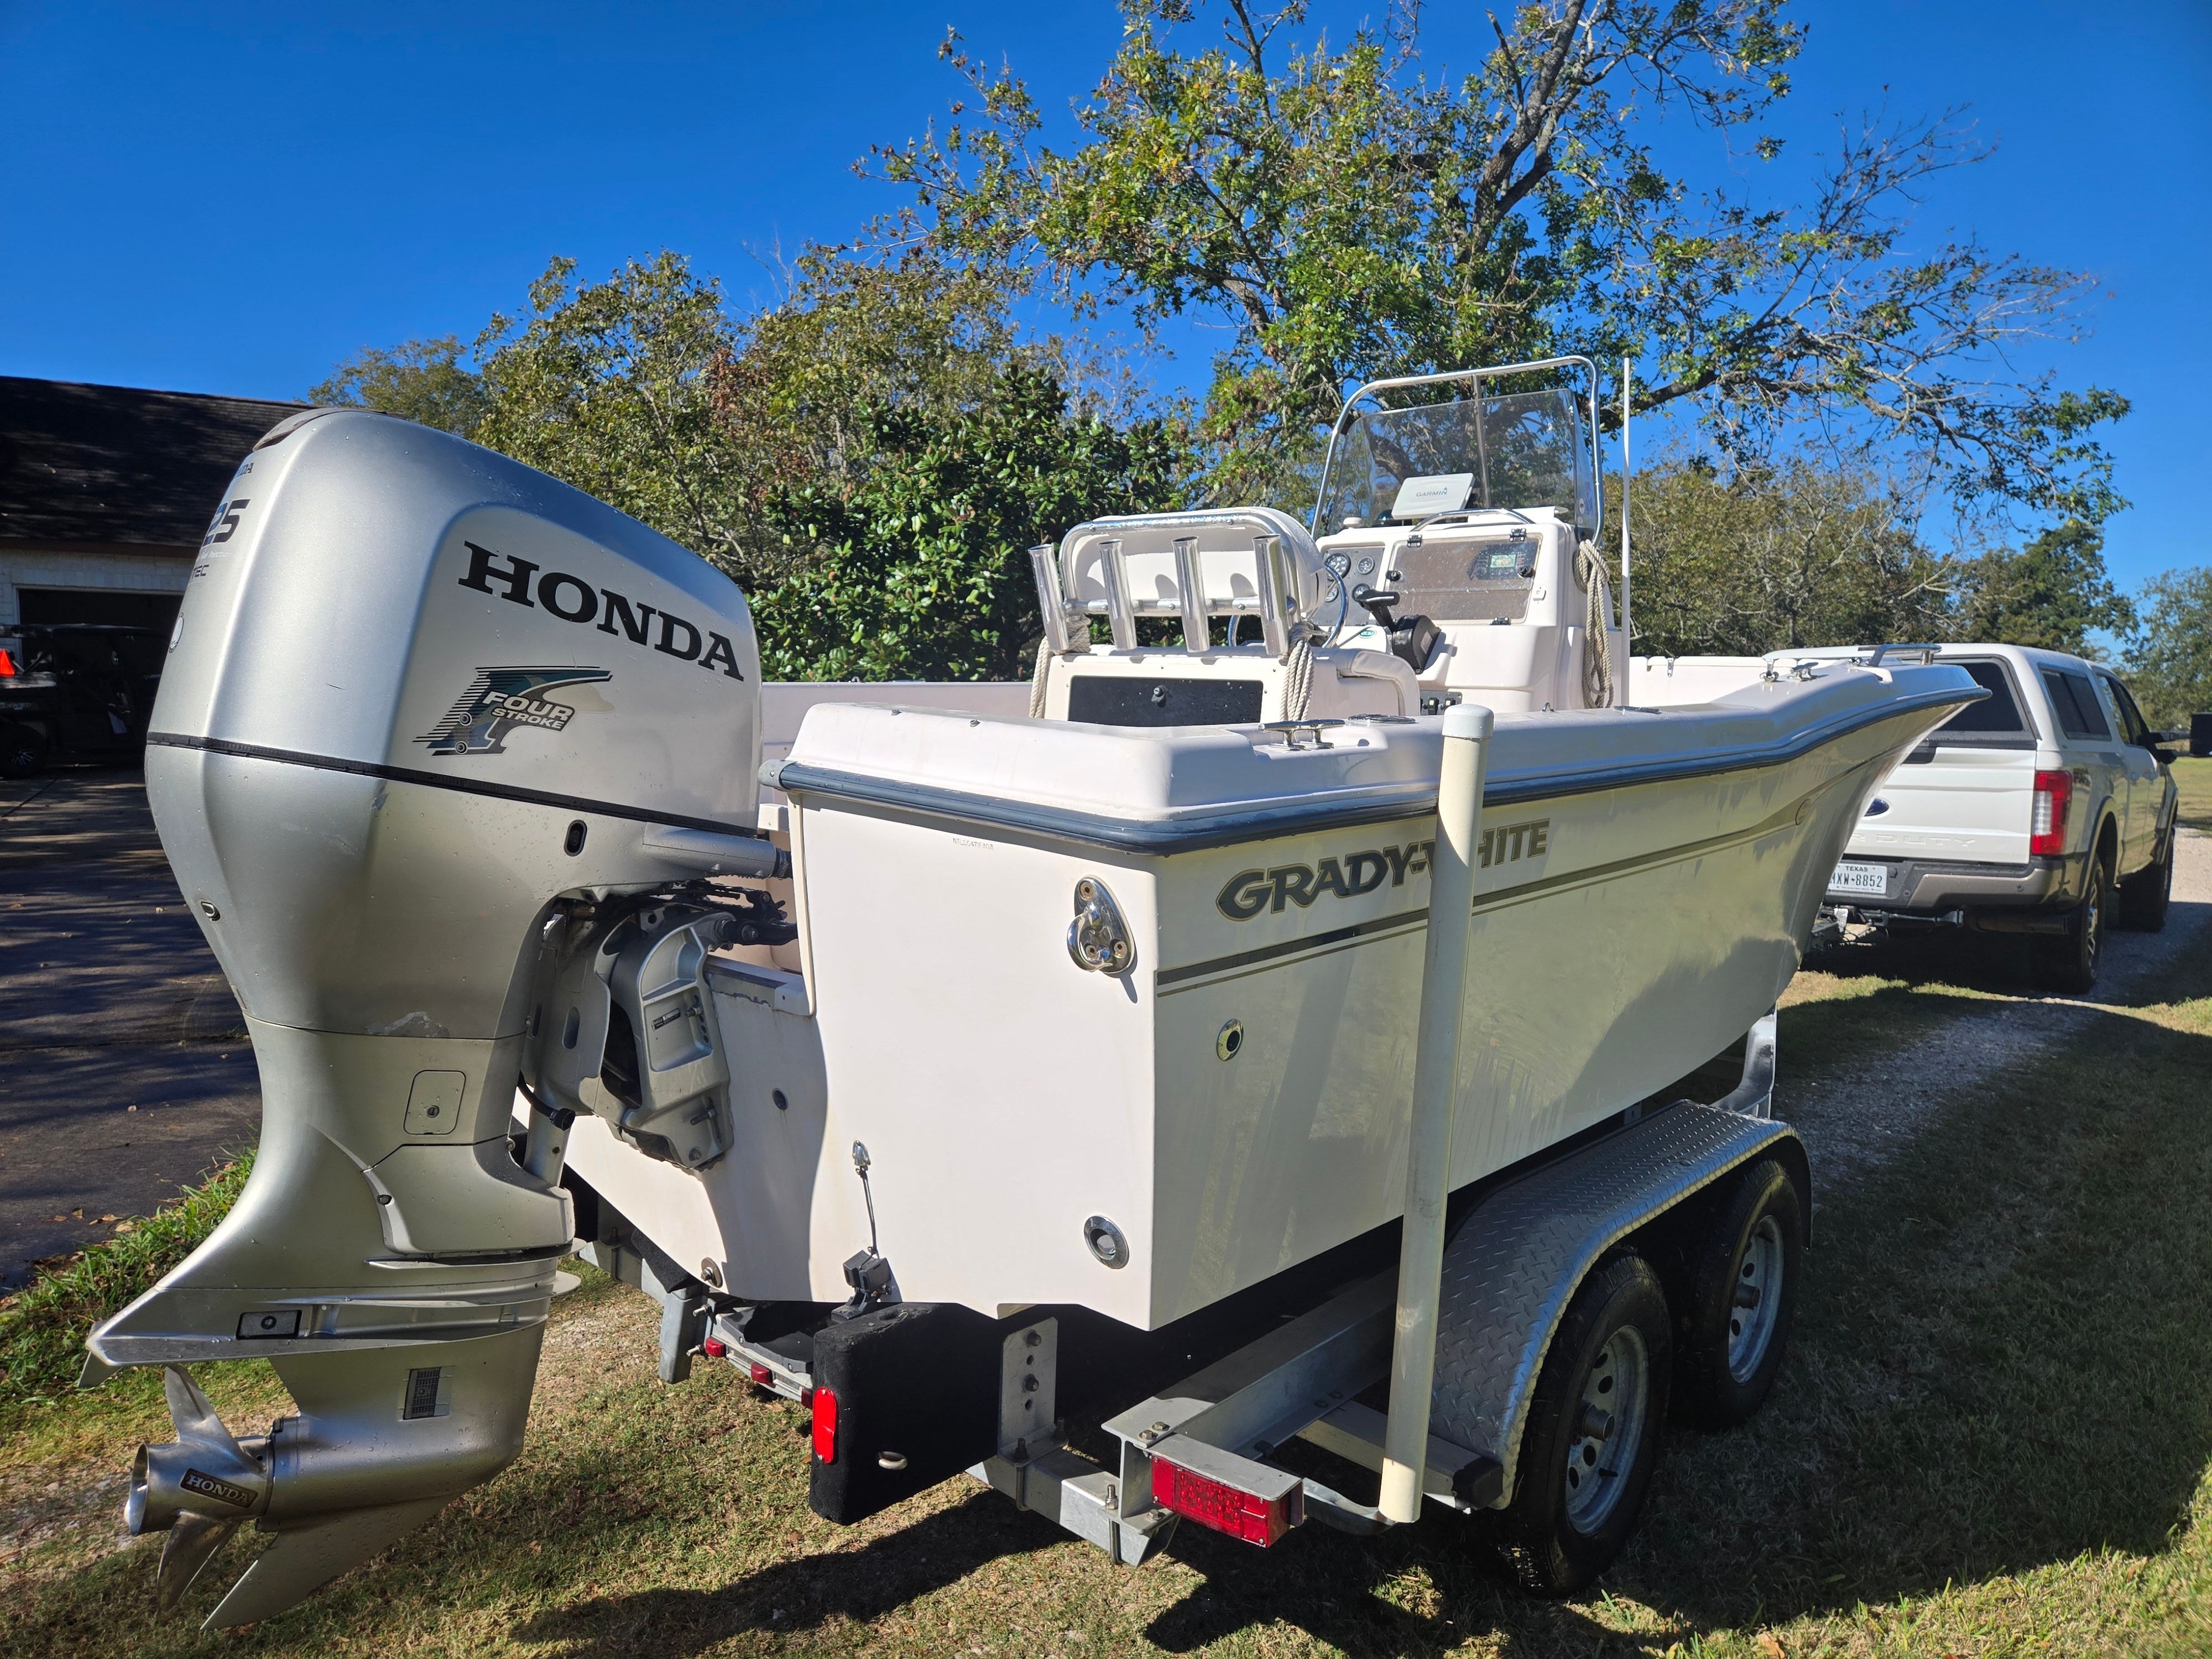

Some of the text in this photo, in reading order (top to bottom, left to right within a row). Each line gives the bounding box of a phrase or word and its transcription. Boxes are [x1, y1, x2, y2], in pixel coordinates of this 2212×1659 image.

[457, 540, 744, 682] HONDA
[482, 691, 573, 721] FOUR
[492, 707, 565, 729] STROKE
[1876, 834, 1976, 847] DUTY
[1216, 818, 1550, 921] GRADY-HITE
[186, 1474, 249, 1503] HONDA
